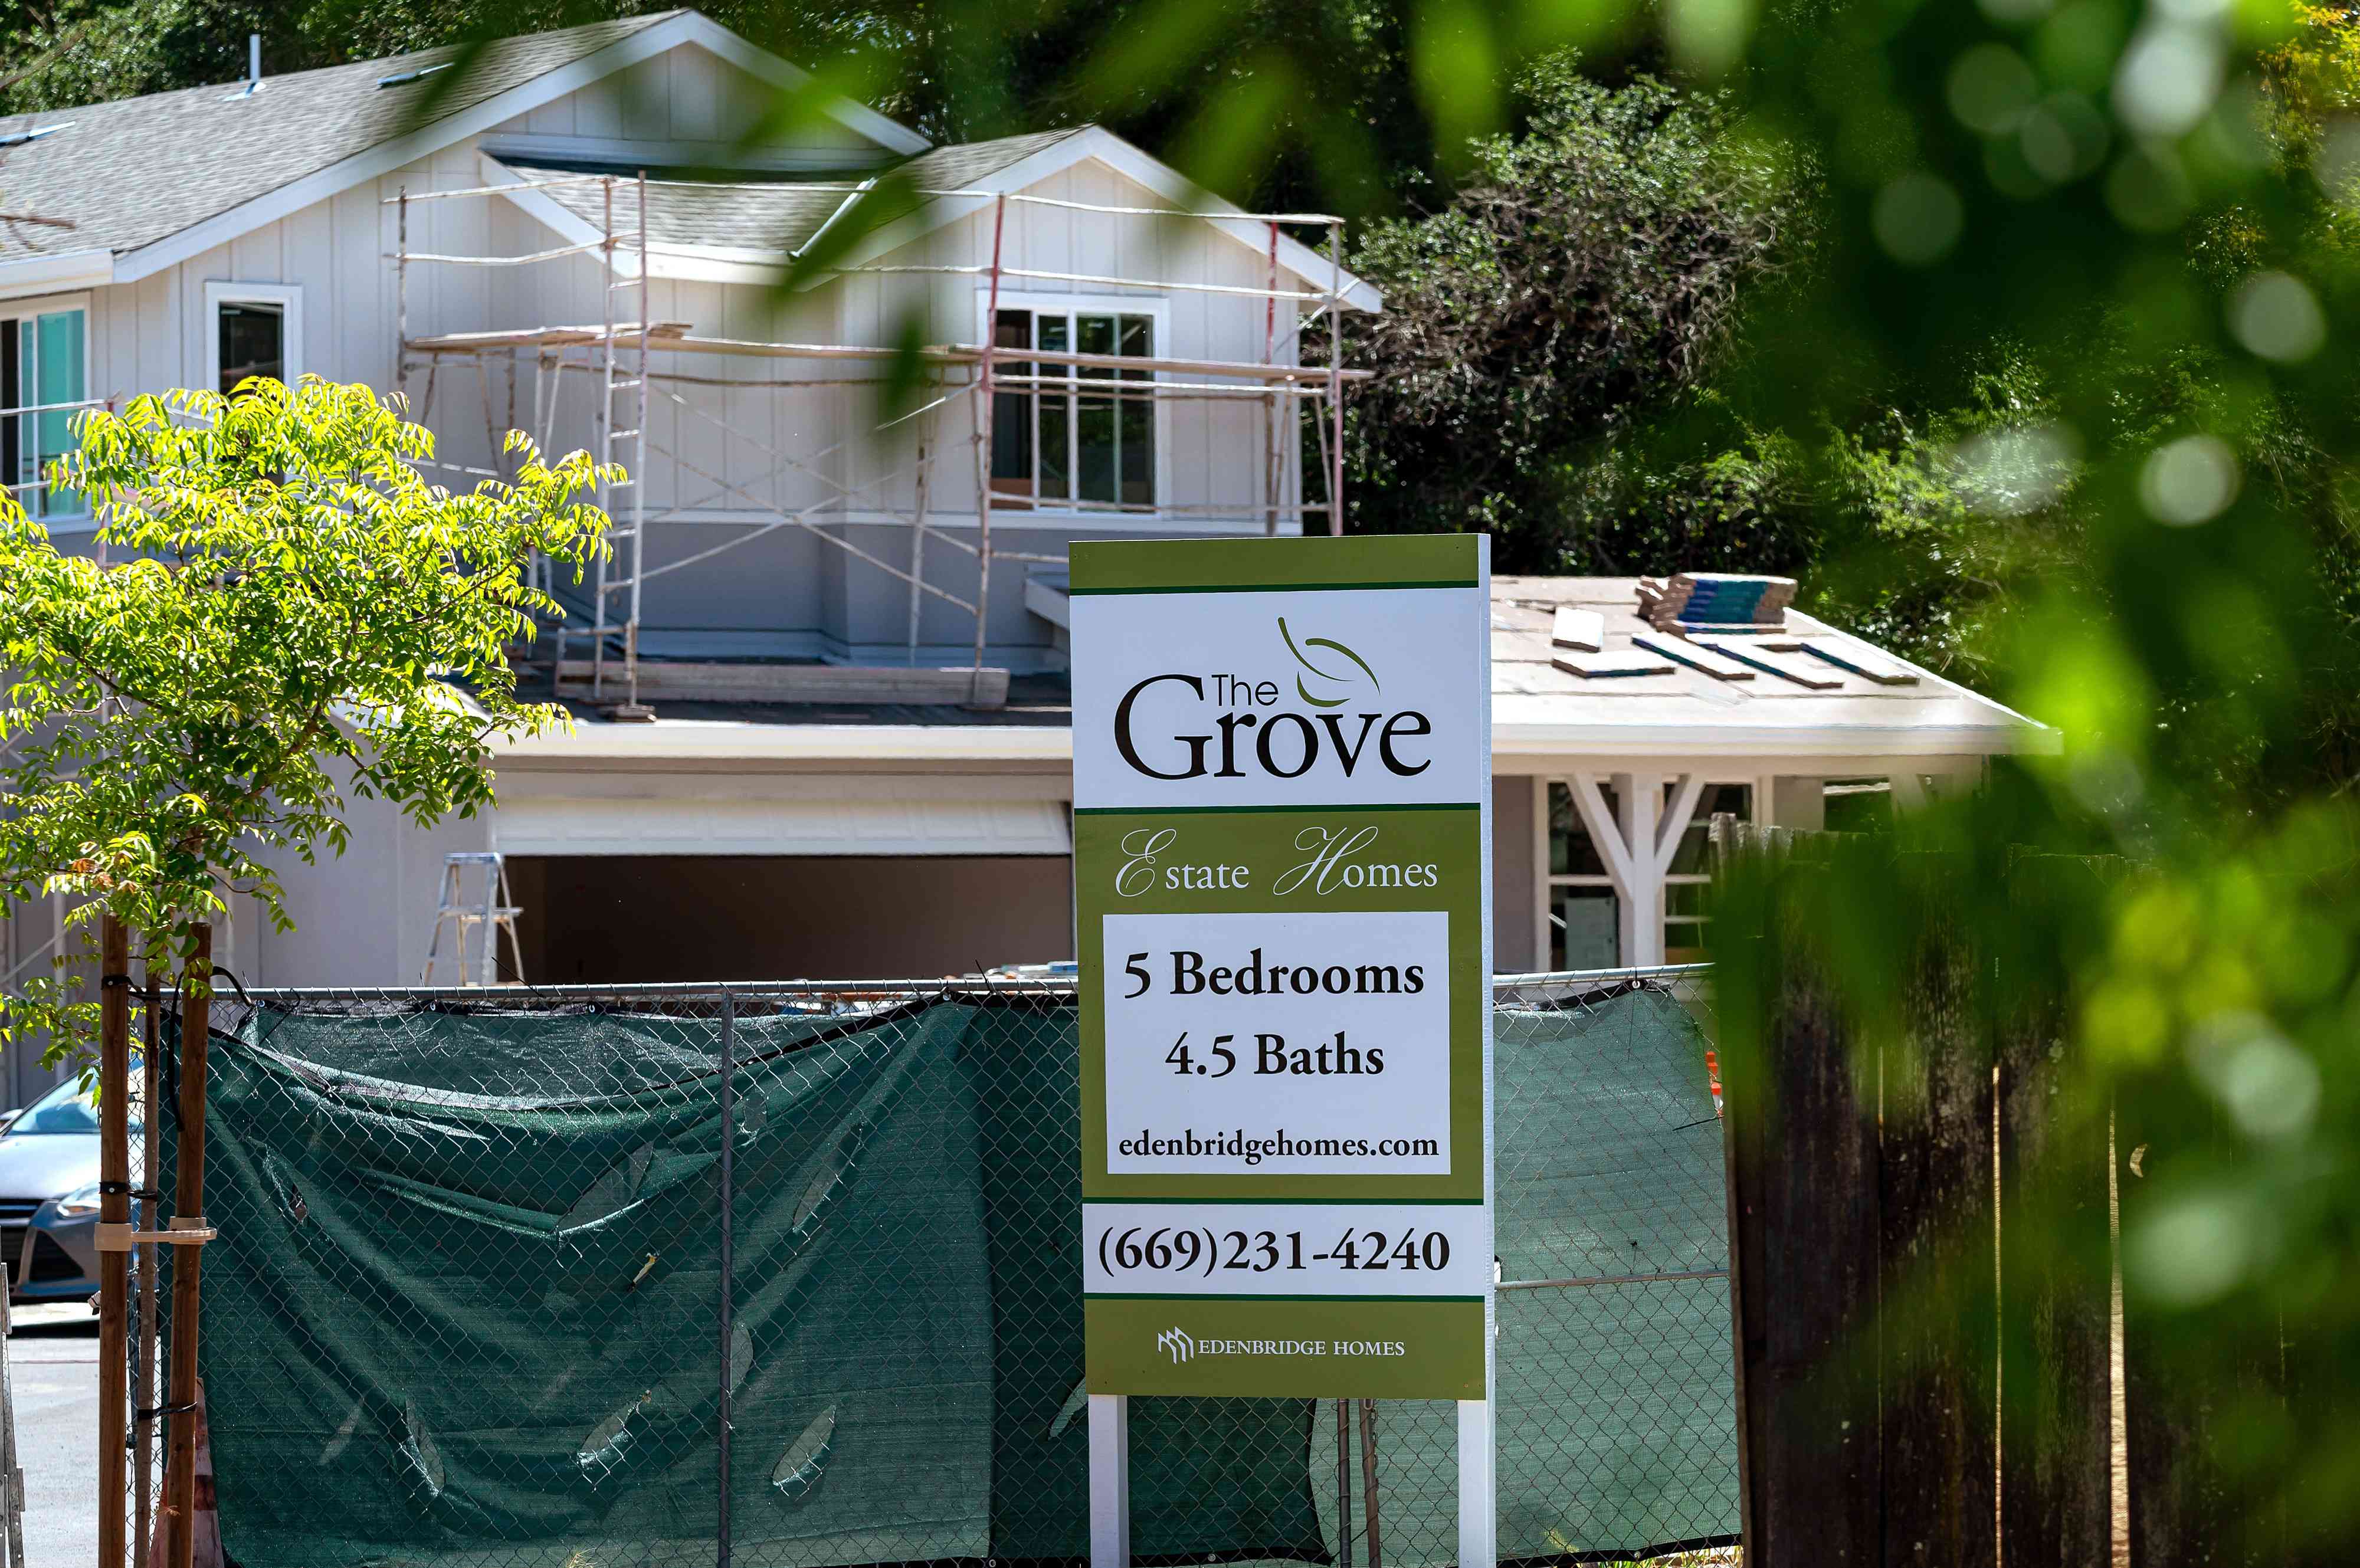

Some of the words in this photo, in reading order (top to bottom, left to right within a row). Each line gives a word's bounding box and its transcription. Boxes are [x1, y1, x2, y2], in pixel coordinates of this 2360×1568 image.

[1211, 674, 1279, 706] The
[1114, 674, 1431, 780] Grove
[1115, 828, 1250, 897] Estate
[1273, 826, 1438, 895] Homes
[1123, 952, 1151, 998] 5
[1169, 947, 1425, 995] Bedrooms
[1165, 1031, 1236, 1078] 4.5
[1253, 1031, 1385, 1075] Baths
[1118, 1129, 1440, 1165] edenbridgehomes.com
[1099, 1226, 1450, 1277] (669)231-4240
[1198, 1339, 1327, 1356] EDENBRIDGE
[1333, 1340, 1405, 1357] HOMES
